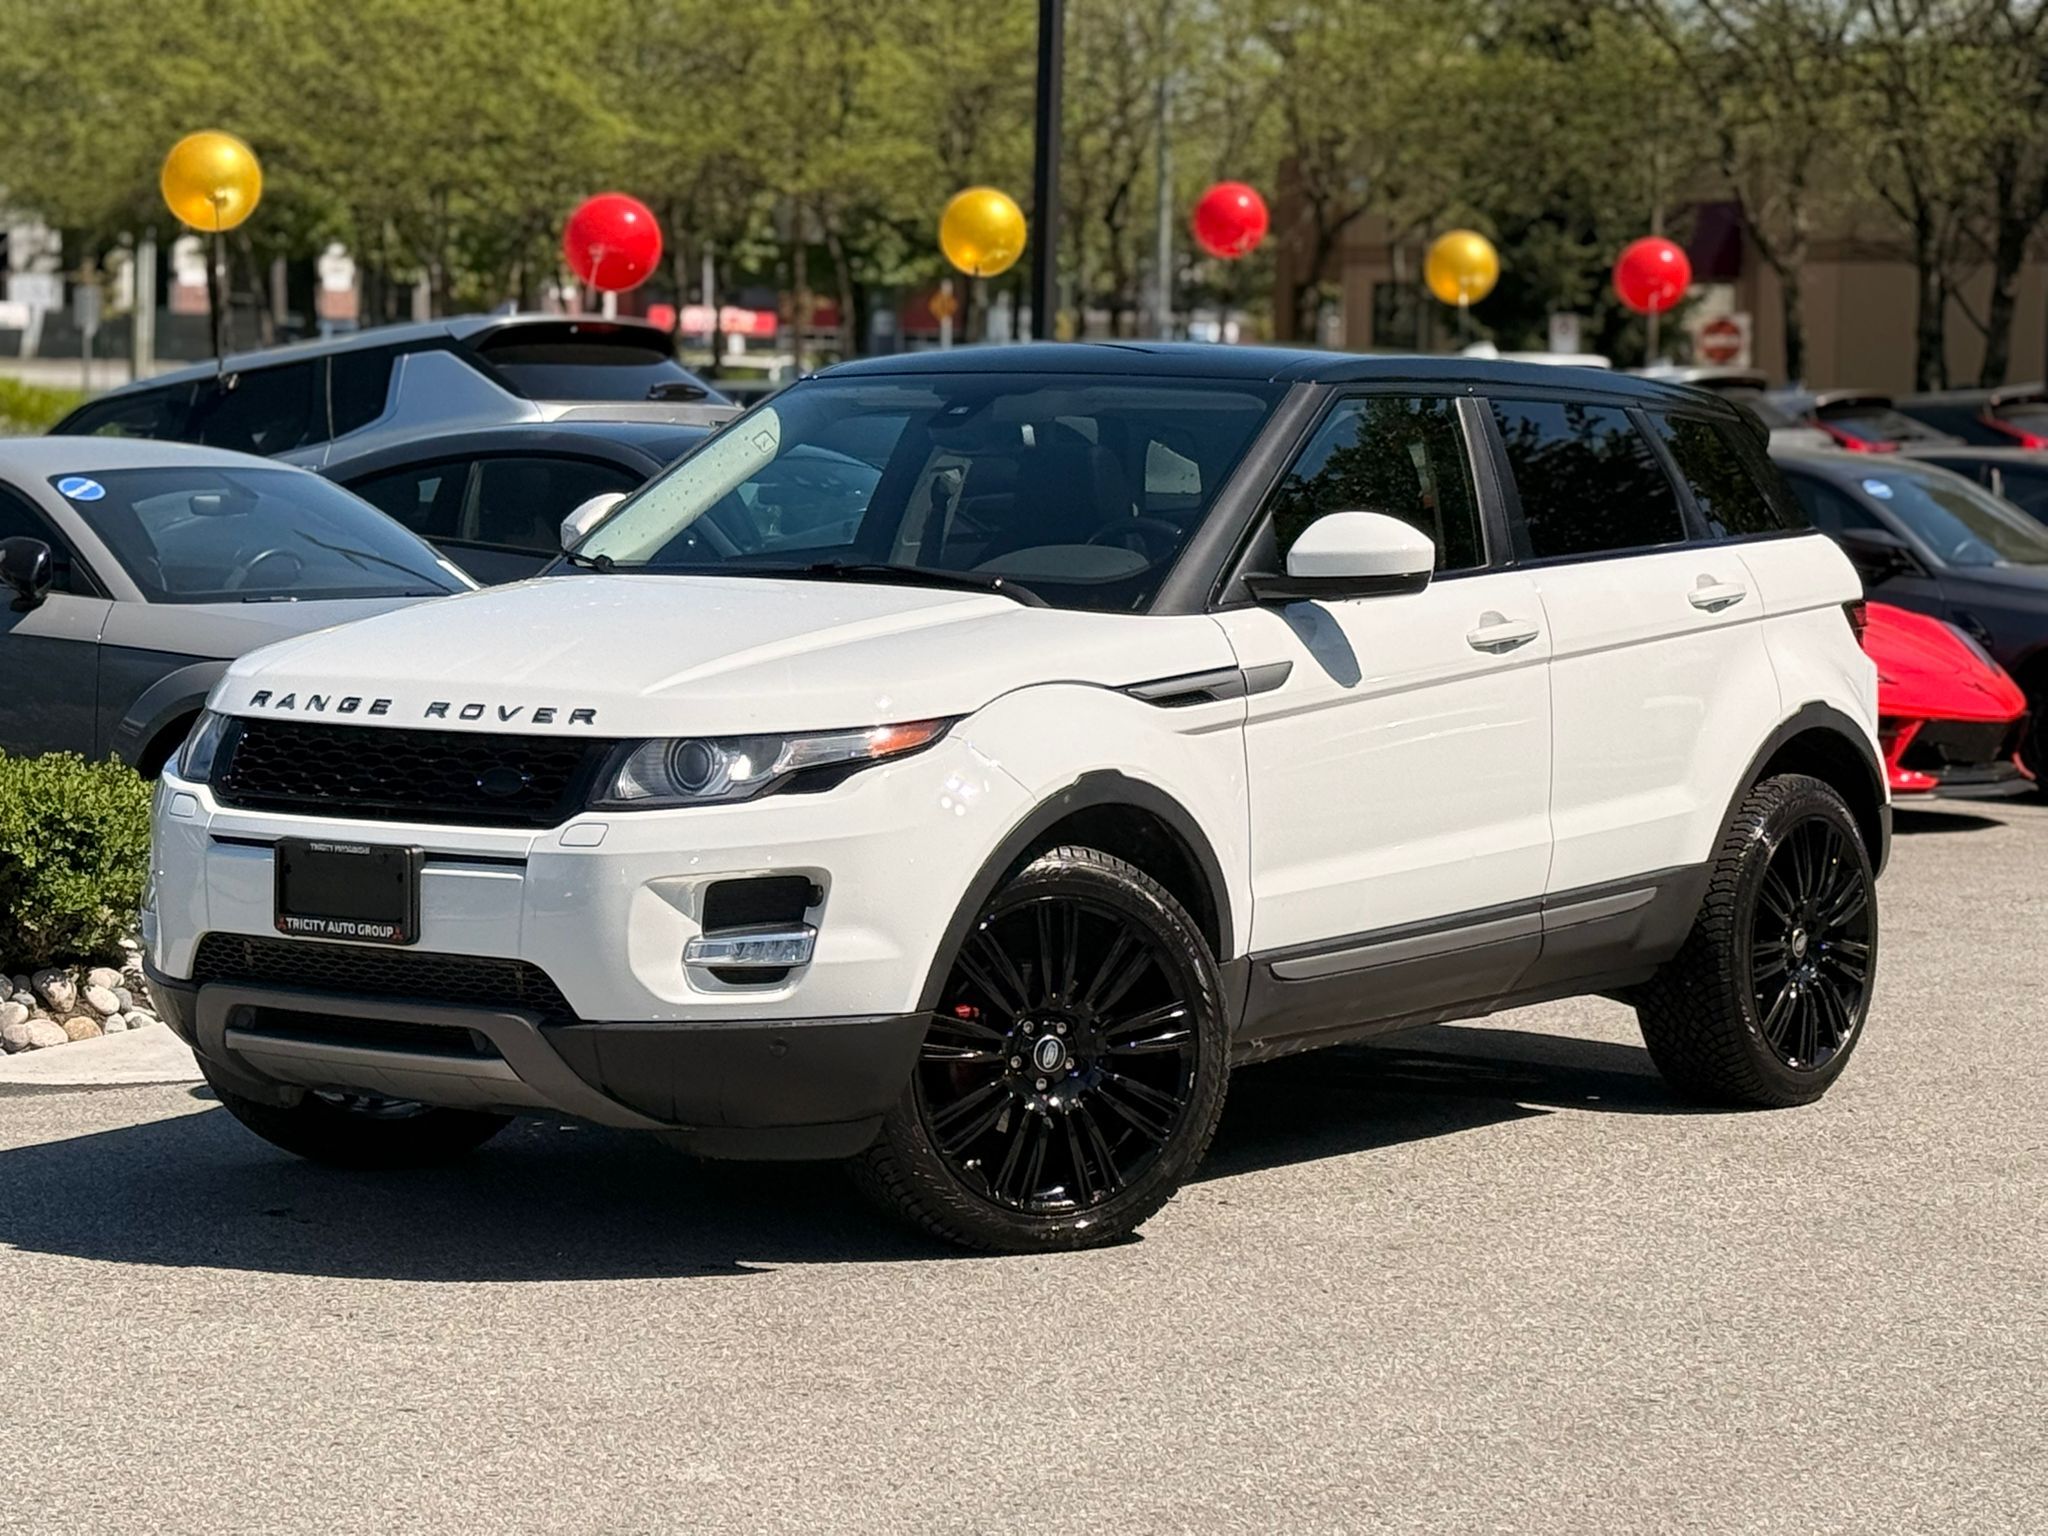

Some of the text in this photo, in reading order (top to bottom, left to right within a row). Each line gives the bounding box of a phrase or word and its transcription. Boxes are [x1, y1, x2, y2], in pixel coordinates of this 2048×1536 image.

[249, 690, 597, 725] RANGE ROVER
[286, 917, 394, 938] TRICITY AUTO GROUP
